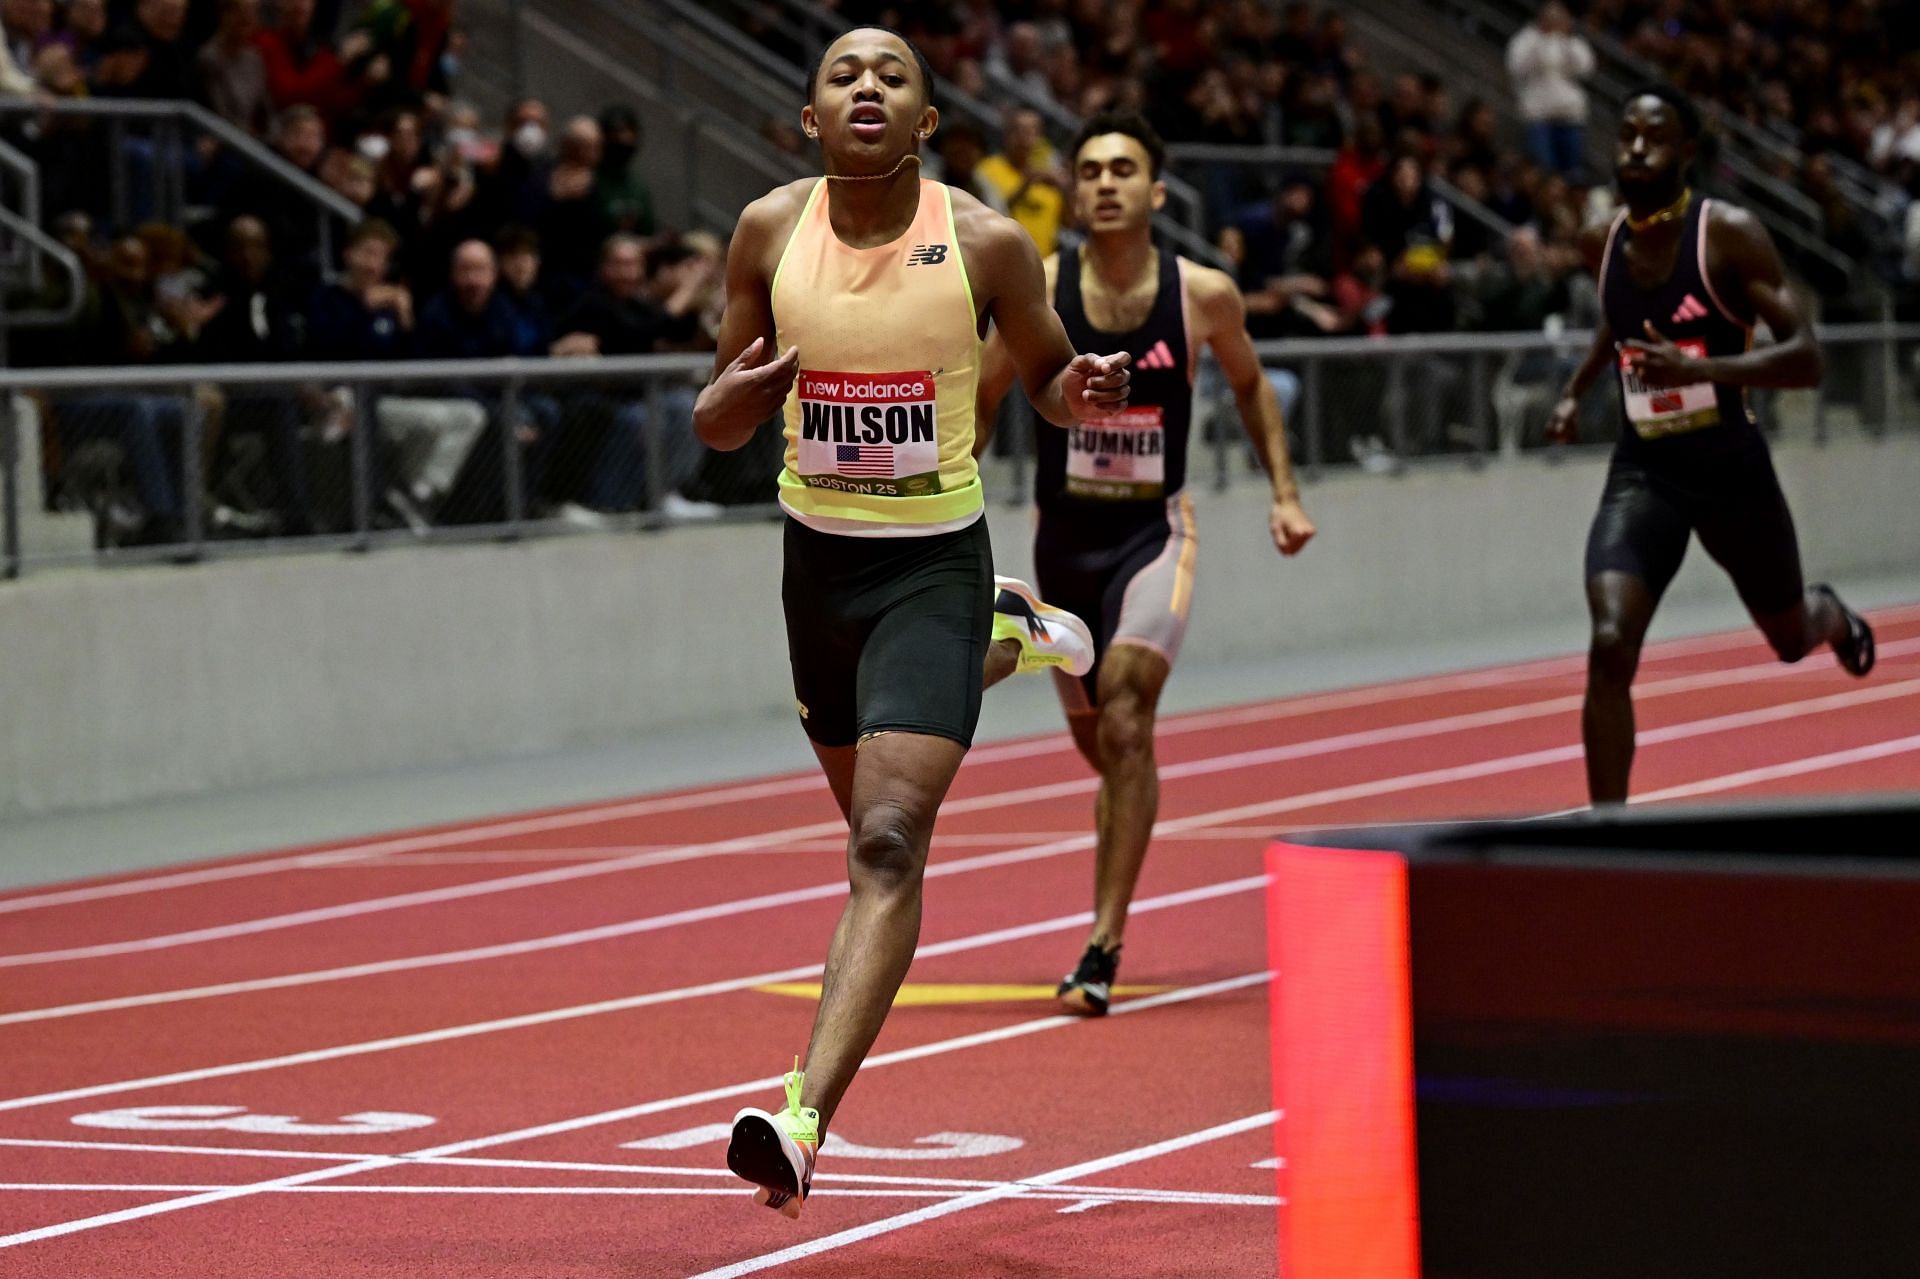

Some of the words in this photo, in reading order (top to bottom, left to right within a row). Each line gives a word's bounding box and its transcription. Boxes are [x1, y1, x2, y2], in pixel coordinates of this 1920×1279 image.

[907, 244, 948, 266] NB
[806, 380, 839, 397] new
[843, 380, 925, 398] balance
[801, 401, 934, 444] WILSON
[1070, 429, 1160, 456] SUMNER
[808, 476, 872, 495] BOSTON
[875, 483, 897, 495] 25
[70, 1105, 437, 1135] 3
